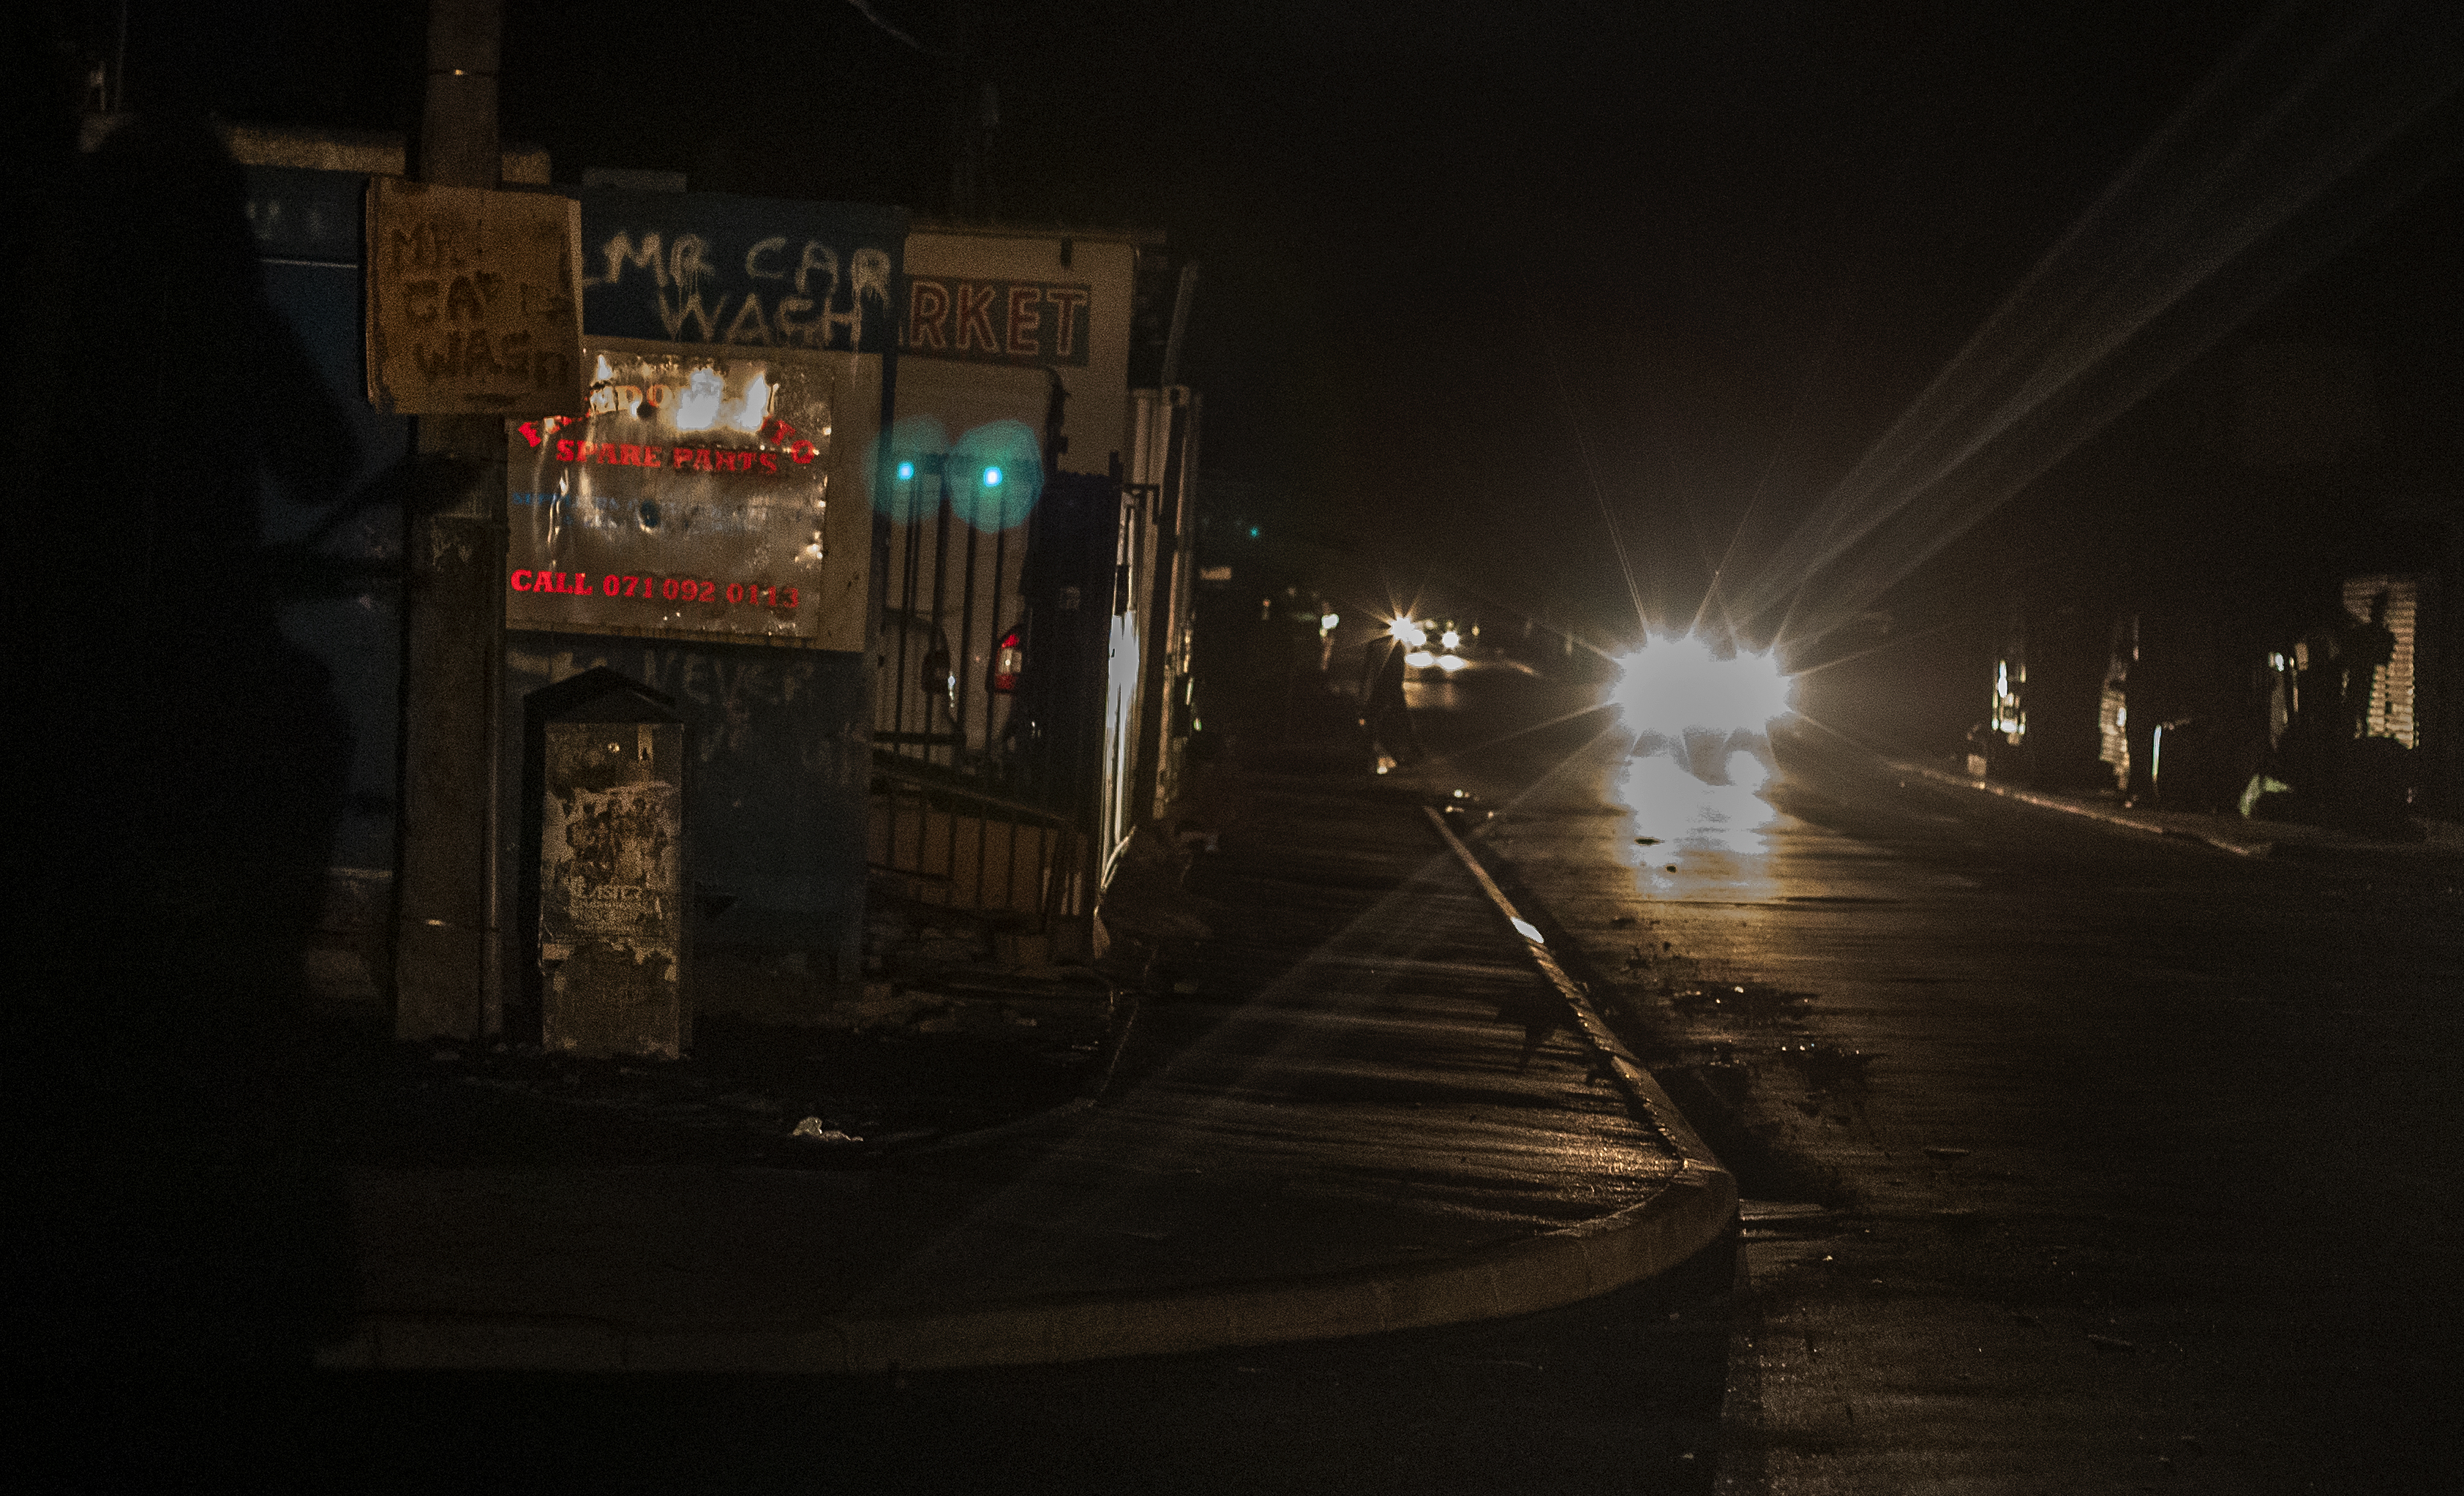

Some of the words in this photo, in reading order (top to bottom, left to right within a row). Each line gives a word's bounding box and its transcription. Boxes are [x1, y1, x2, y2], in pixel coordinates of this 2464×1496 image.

[745, 236, 893, 297] CAR
[658, 290, 863, 347] WASH
[556, 439, 662, 469] SPARE
[672, 446, 778, 476] PARTS
[511, 569, 593, 595] CALL
[604, 575, 653, 598] 071
[663, 579, 715, 603] 092
[726, 582, 799, 608] 0113
